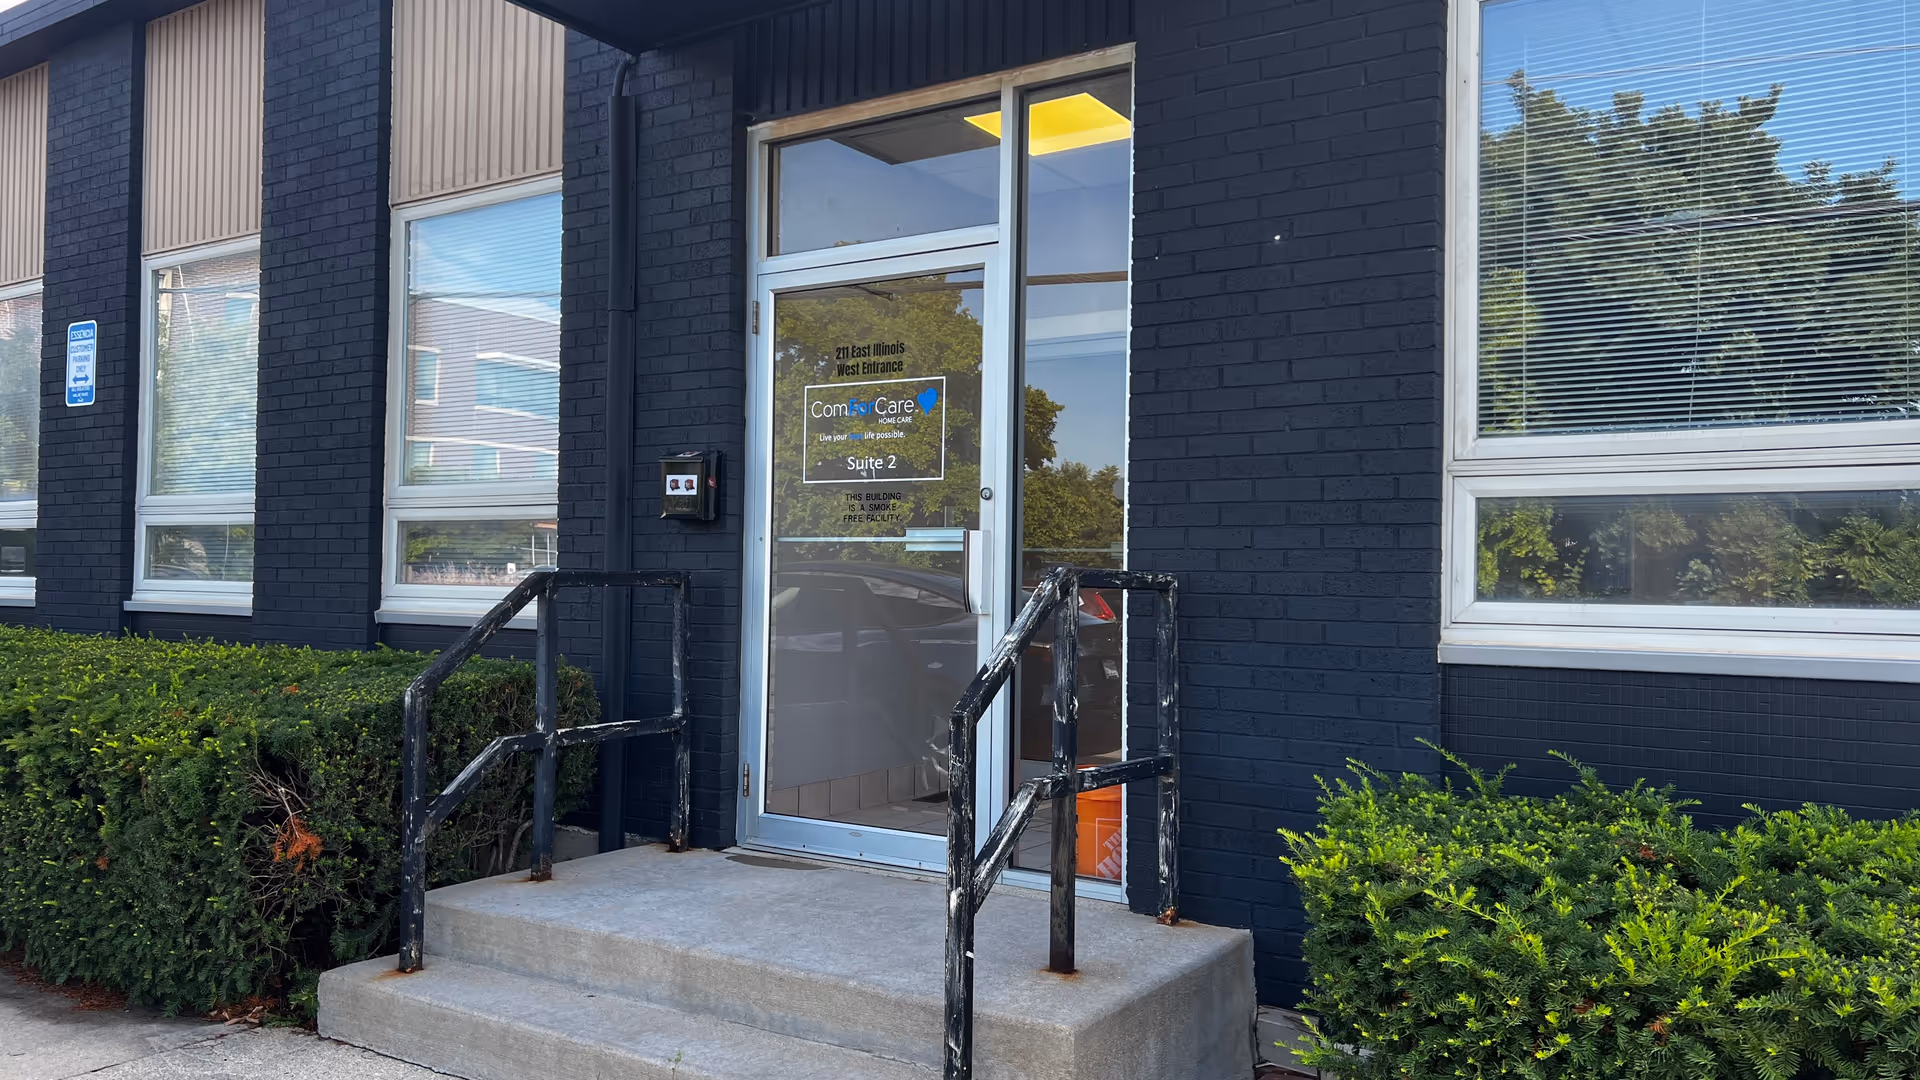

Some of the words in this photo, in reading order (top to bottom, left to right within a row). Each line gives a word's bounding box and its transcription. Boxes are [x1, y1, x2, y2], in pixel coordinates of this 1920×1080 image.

[836, 347, 849, 360] 211
[852, 344, 870, 358] East
[873, 341, 905, 356] Illinois
[72, 355, 90, 363] PARKING
[837, 363, 859, 377] West
[862, 360, 903, 374] Entrance
[811, 397, 914, 418] ComForCare
[896, 416, 912, 424] CARE
[819, 434, 832, 442] Live
[833, 434, 847, 442] your
[864, 432, 875, 440] life
[847, 457, 883, 470] Suite
[887, 455, 897, 469] 2
[865, 492, 902, 501] BUILDING
[868, 503, 897, 511] SMOKE
